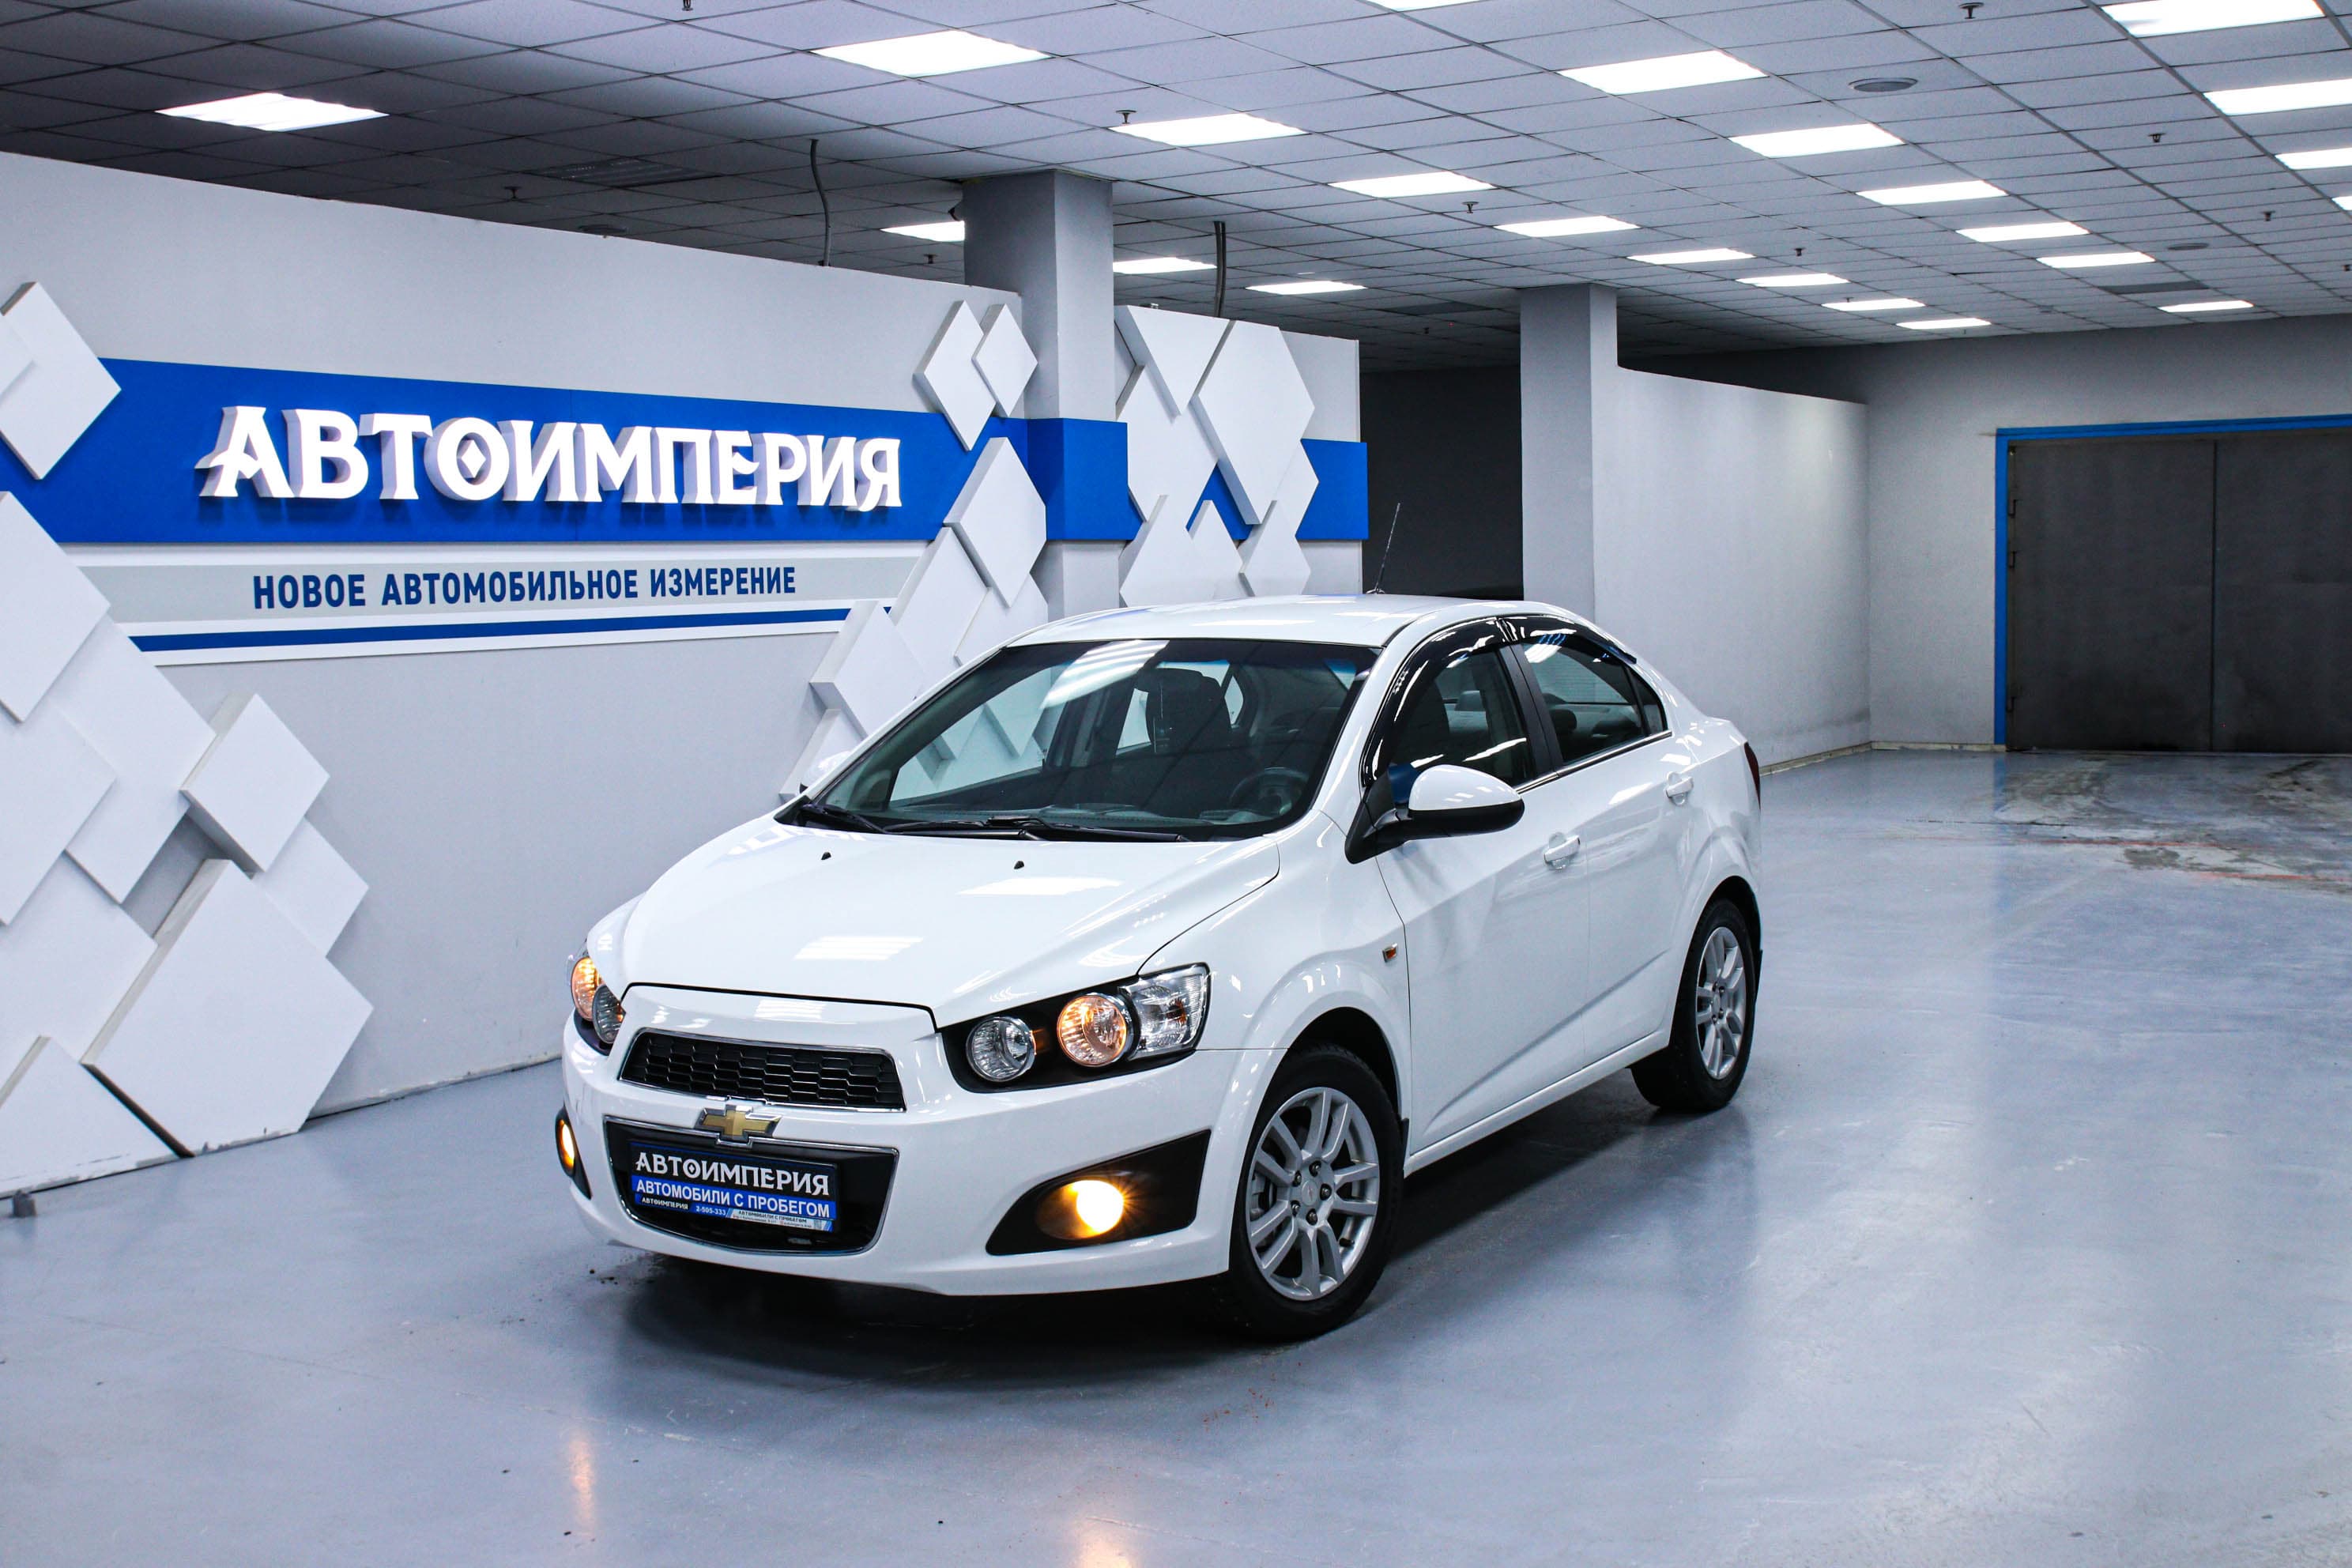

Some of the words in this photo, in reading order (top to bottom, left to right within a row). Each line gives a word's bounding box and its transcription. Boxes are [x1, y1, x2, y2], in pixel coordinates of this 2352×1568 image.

[195, 405, 901, 512] АВТОИМПЕРИЯ
[253, 575, 365, 609] НОВОЕ
[381, 567, 638, 605] АВТОМОБИЛЬНОЕ
[650, 566, 796, 598] ИЗМЕРЕНИЕ
[635, 1152, 830, 1196] АВТОИМПЕРИЯ
[636, 1179, 730, 1205] АВТОМОБИЛИ
[733, 1193, 744, 1207] С
[748, 1195, 830, 1218] ПРОБЕГОМ
[642, 1197, 688, 1210] АВТОИМПЕРИЯ
